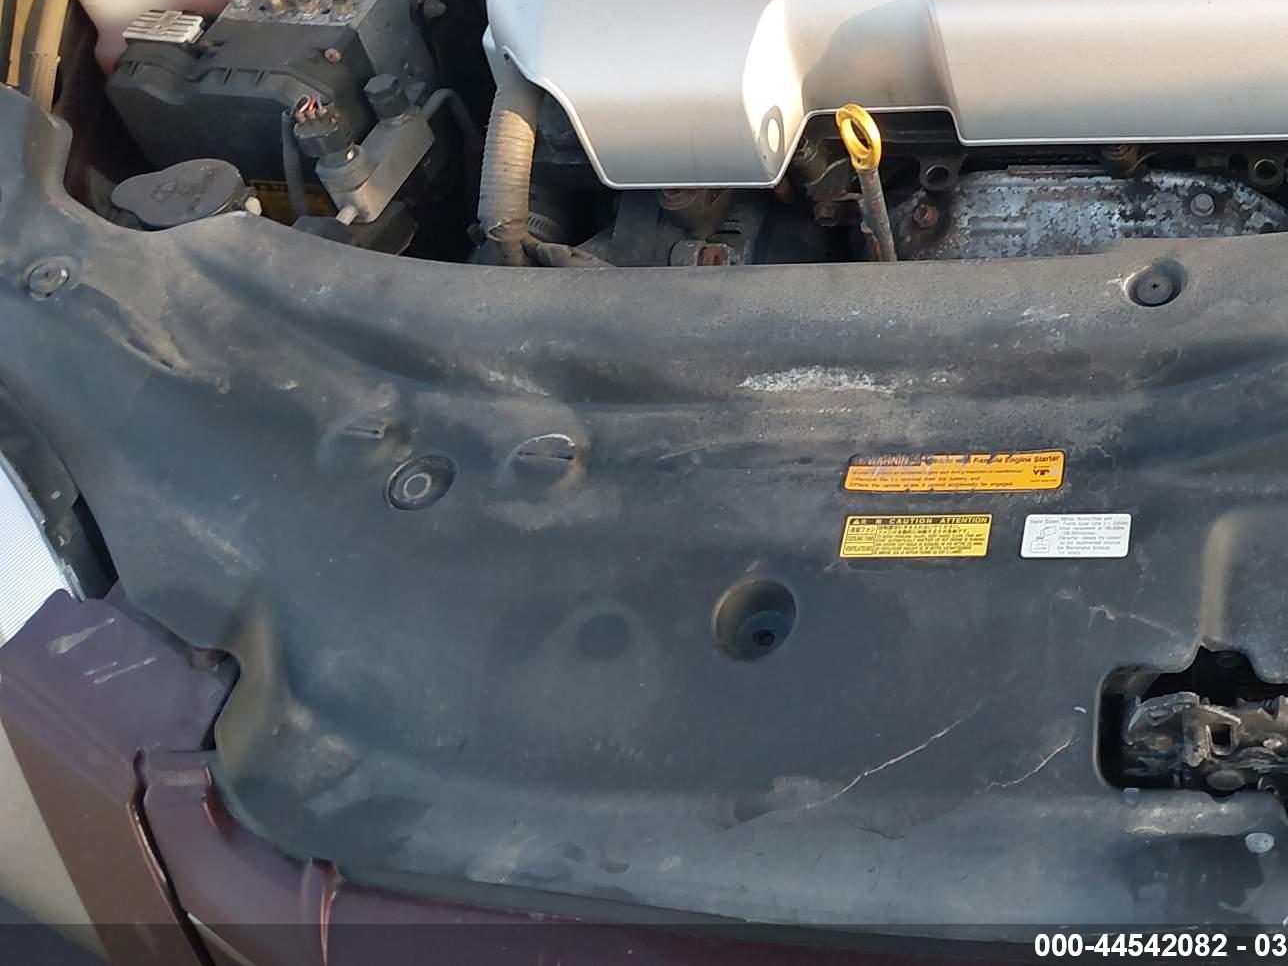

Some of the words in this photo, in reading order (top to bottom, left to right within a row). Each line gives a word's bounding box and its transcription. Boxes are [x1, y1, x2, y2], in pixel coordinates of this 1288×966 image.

[1005, 454, 1032, 465] Engine
[1034, 454, 1061, 464] Starter
[939, 516, 988, 524] ATTENTION
